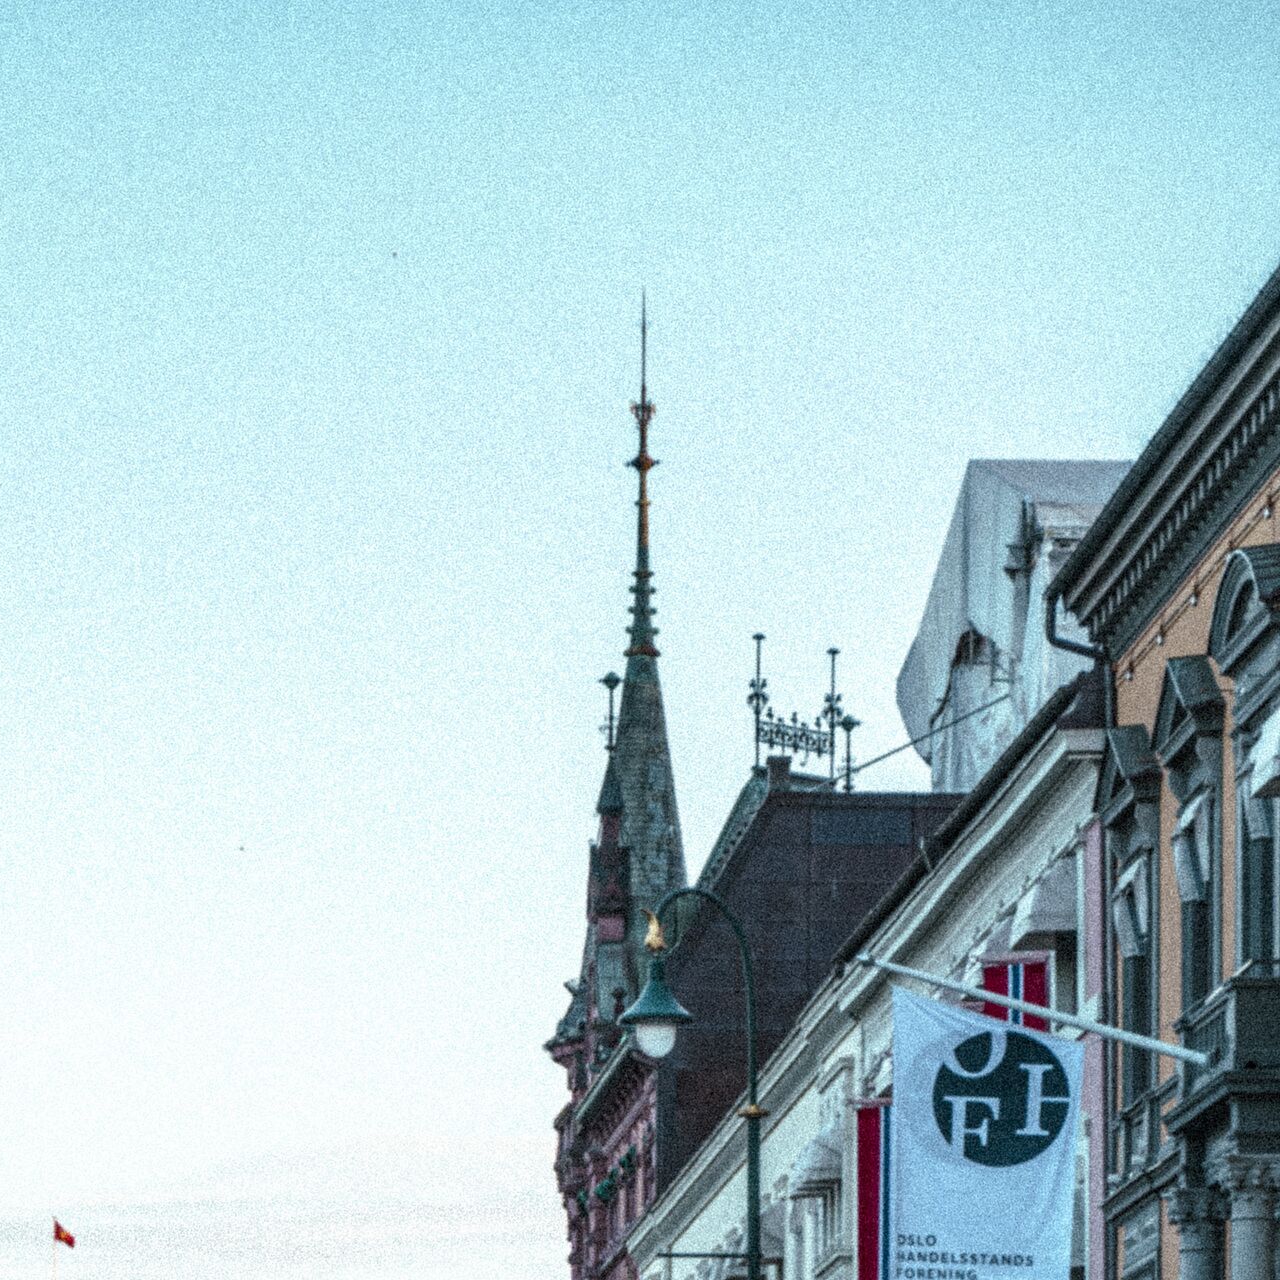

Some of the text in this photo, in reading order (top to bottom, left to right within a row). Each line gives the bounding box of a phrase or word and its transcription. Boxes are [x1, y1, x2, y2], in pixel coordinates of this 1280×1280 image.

[895, 1233, 938, 1247] OSLO
[895, 1251, 1035, 1267] HANDELSSTANDS
[895, 1267, 979, 1280] FORENING
